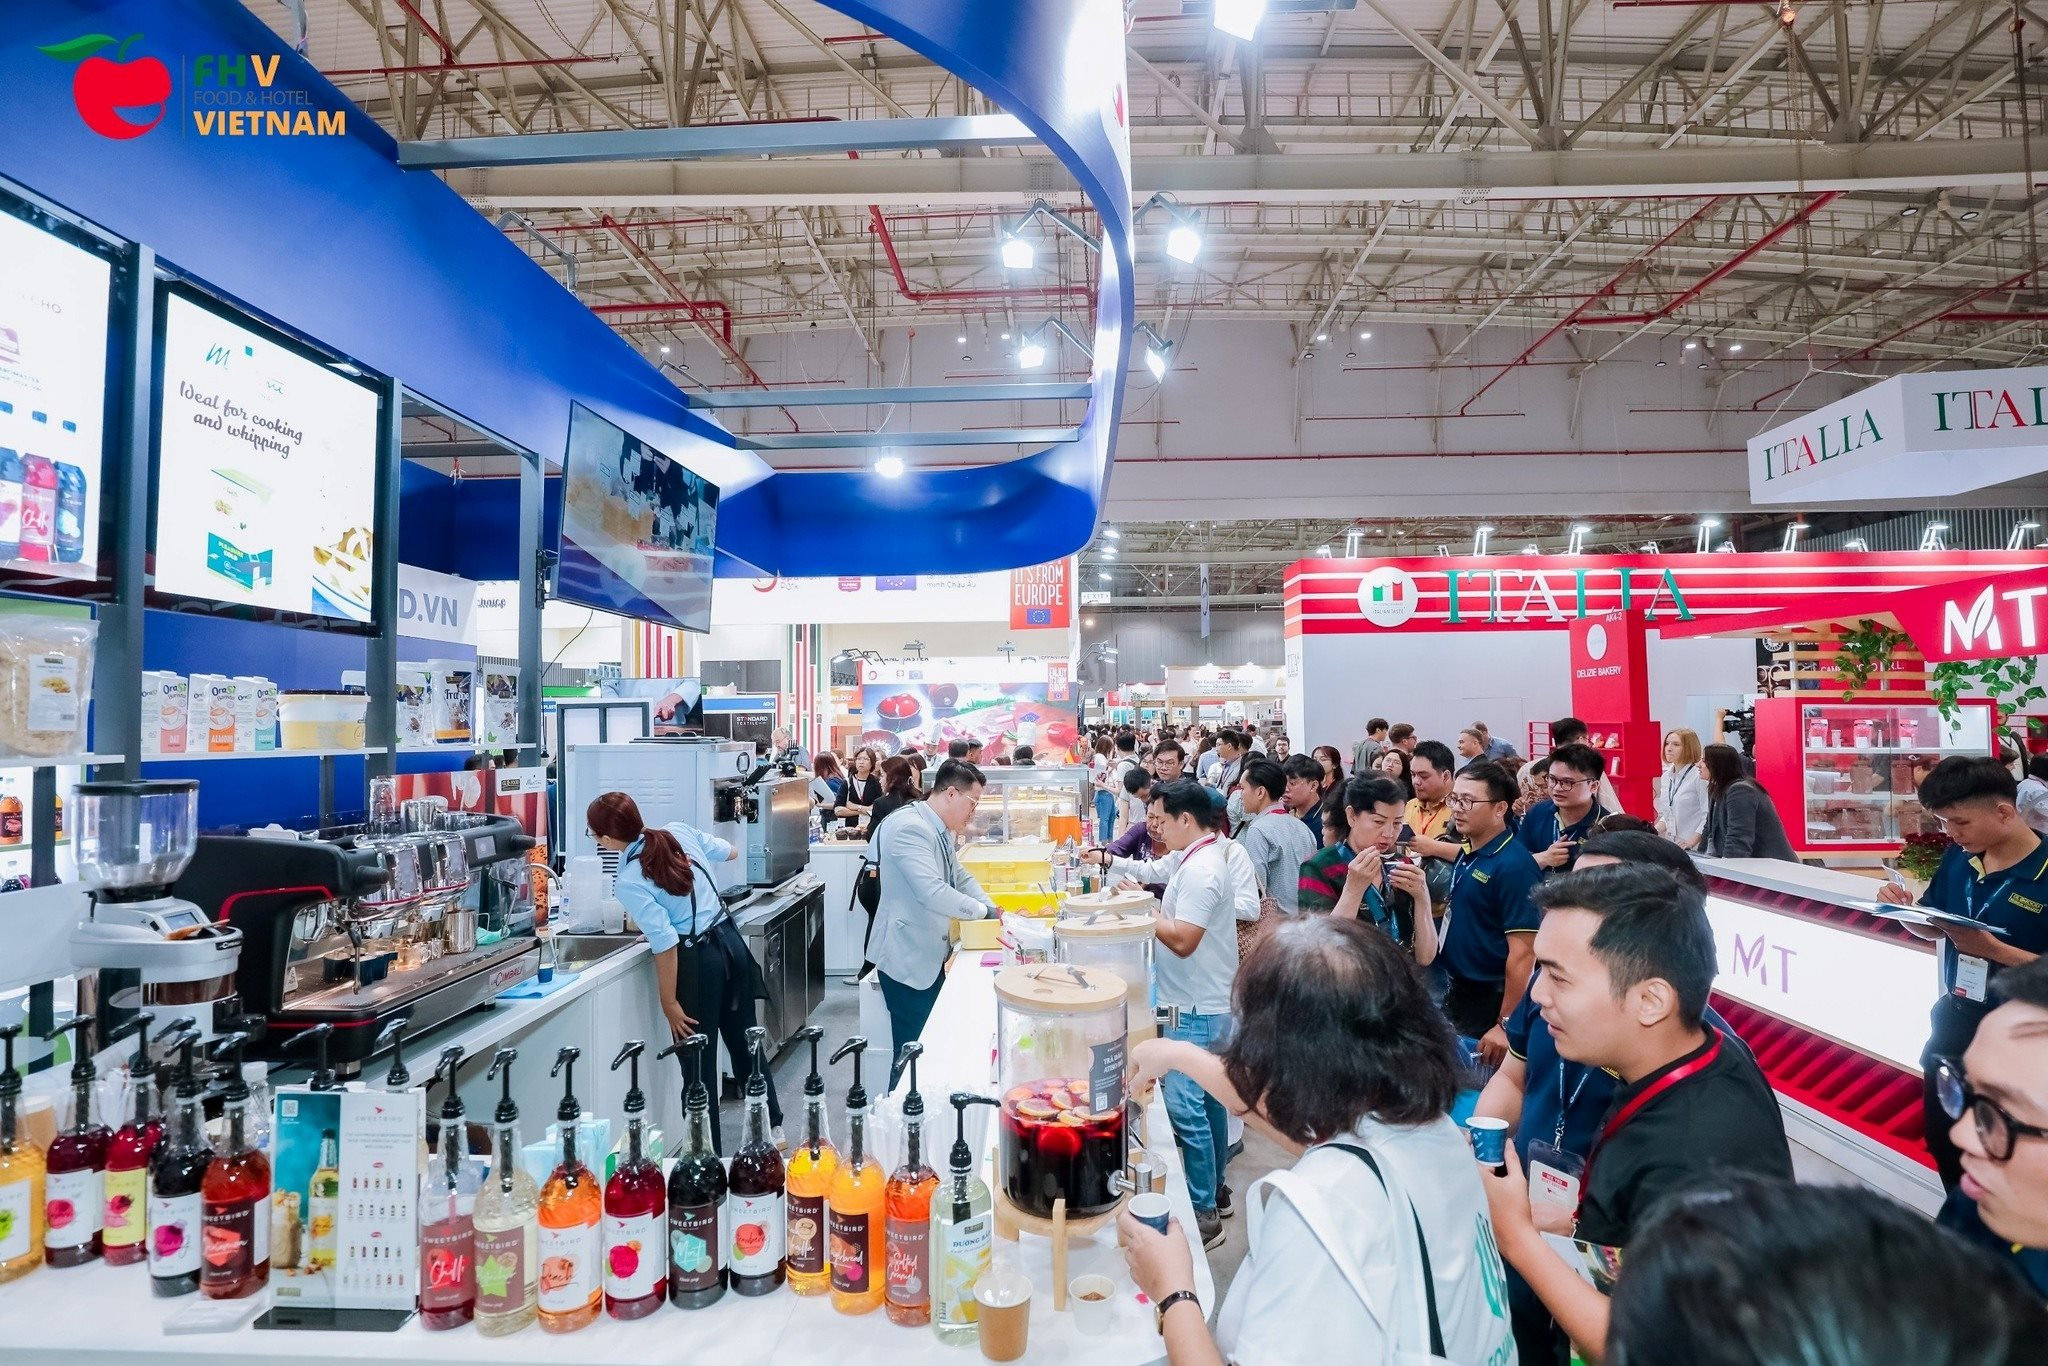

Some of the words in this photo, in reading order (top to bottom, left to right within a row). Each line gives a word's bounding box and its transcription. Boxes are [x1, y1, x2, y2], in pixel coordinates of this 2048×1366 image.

[180, 380, 219, 410] Ideal
[223, 399, 248, 420] for
[252, 415, 303, 446] cooking
[193, 413, 223, 431] and
[227, 424, 290, 460] whipping
[1763, 408, 1884, 482] ITALIA
[1035, 564, 1064, 584] FROM
[1014, 583, 1064, 606] EUROPE
[1605, 611, 1623, 623] AK4-2
[1576, 668, 1598, 679] DELIZIE
[1597, 665, 1621, 676] BAKERY
[670, 1216, 715, 1228] SWEETBIRD
